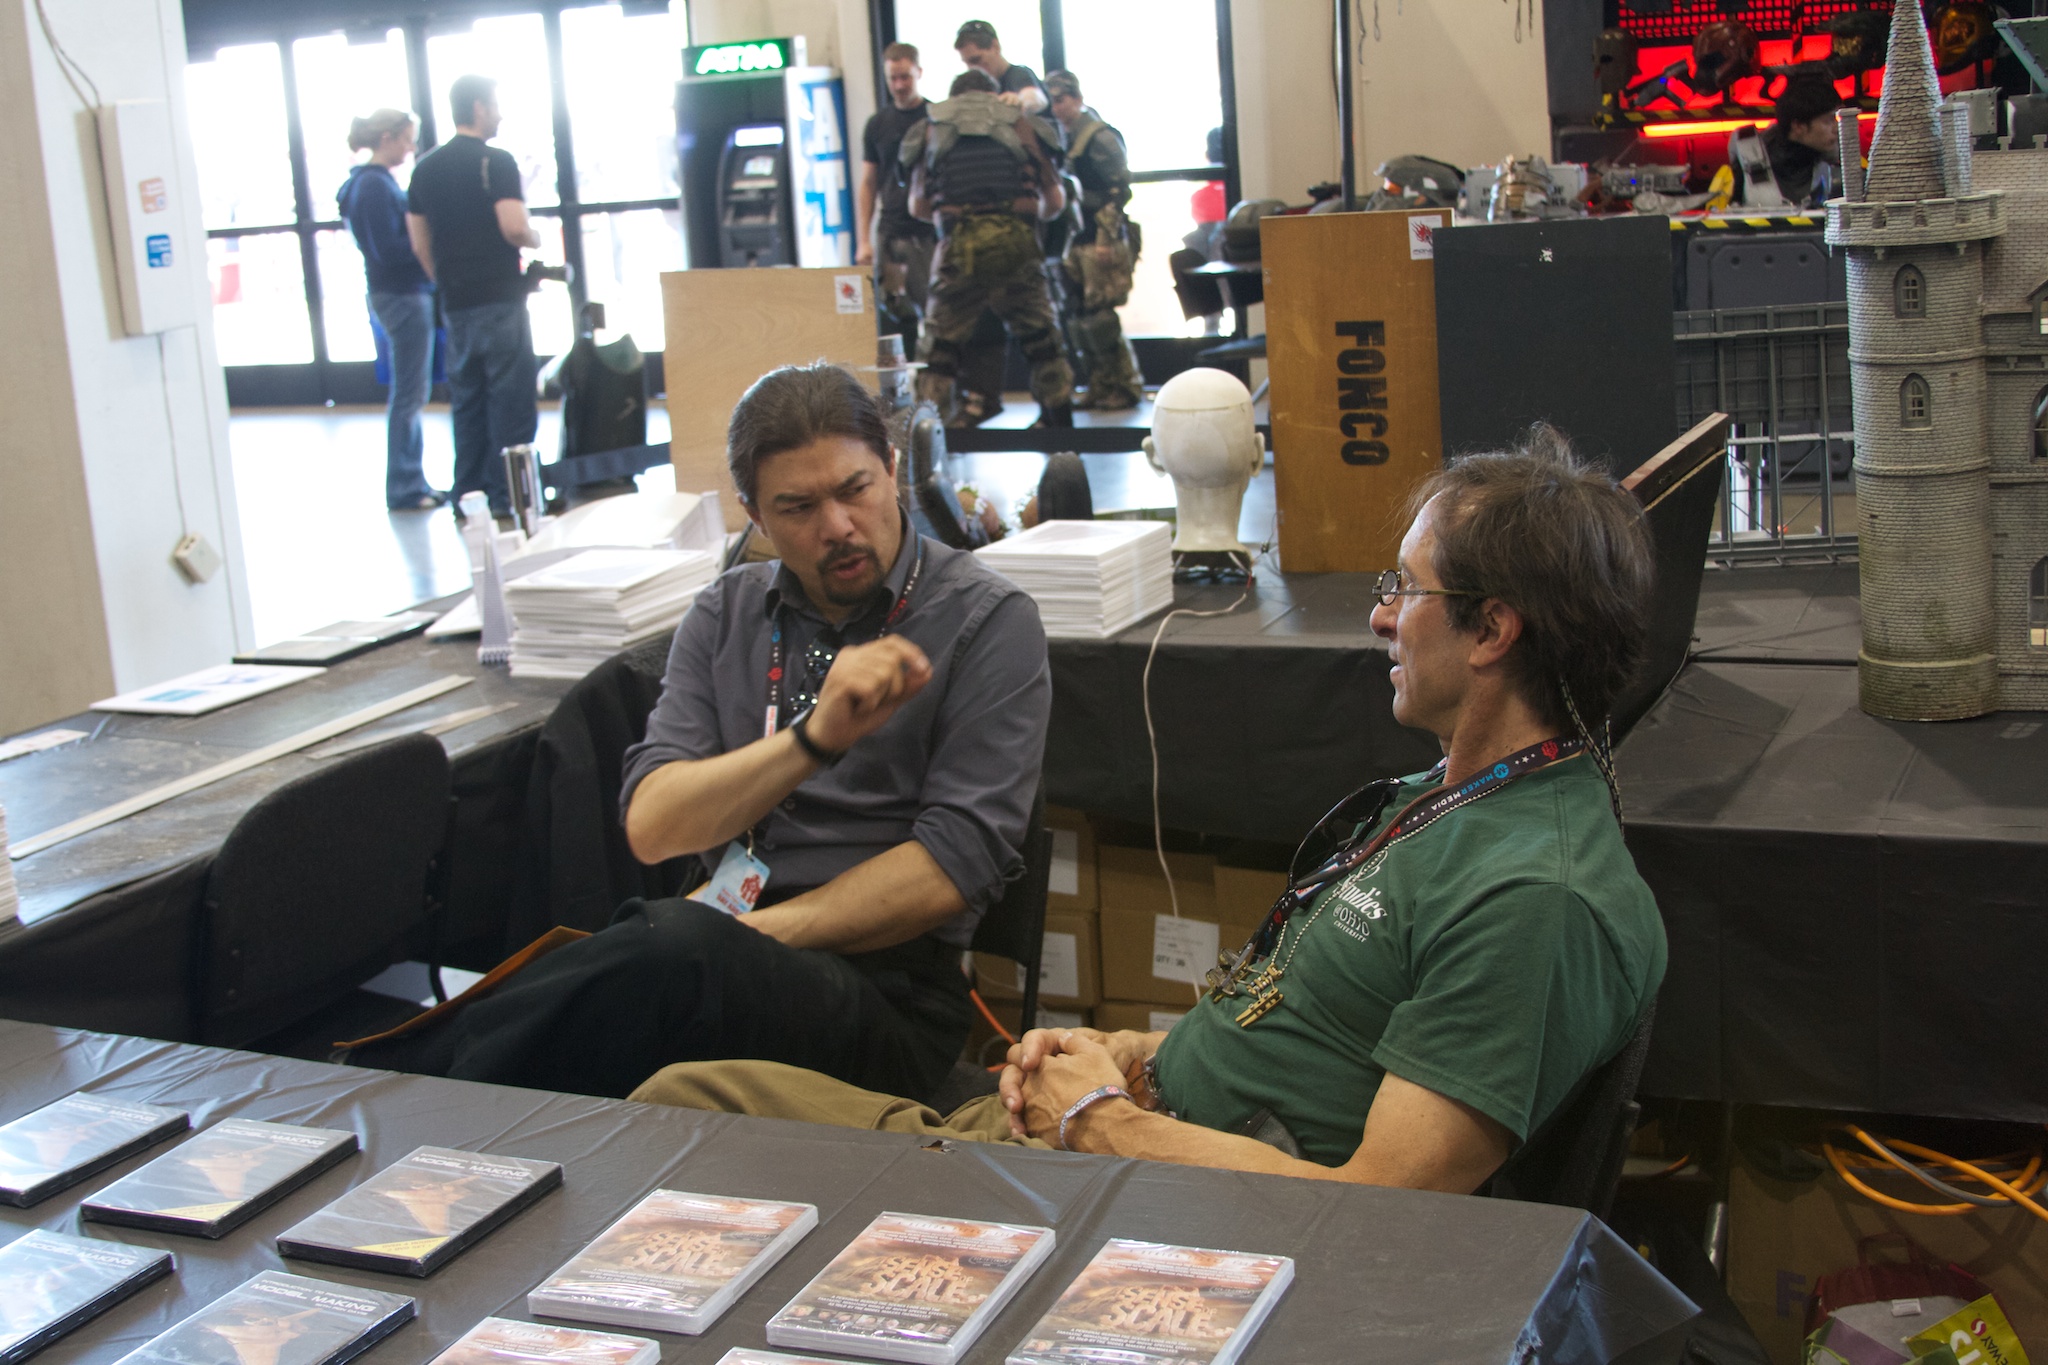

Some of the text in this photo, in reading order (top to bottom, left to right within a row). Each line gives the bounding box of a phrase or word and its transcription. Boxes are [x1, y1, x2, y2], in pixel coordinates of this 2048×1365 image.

[696, 43, 783, 75] ATM
[1335, 320, 1390, 466] FONCO
[269, 1134, 326, 1146] MAKING
[411, 1156, 531, 1178] MODEL MAKING
[648, 1229, 723, 1254] SENSE
[76, 1251, 137, 1266] MAKING
[623, 1249, 727, 1276] SCALE
[882, 1253, 963, 1281] SENSE
[250, 1283, 377, 1312] MODEL MAKING
[860, 1274, 969, 1304] SCALE
[1120, 1284, 1204, 1311] SENSE
[1100, 1303, 1212, 1337] SCALE
